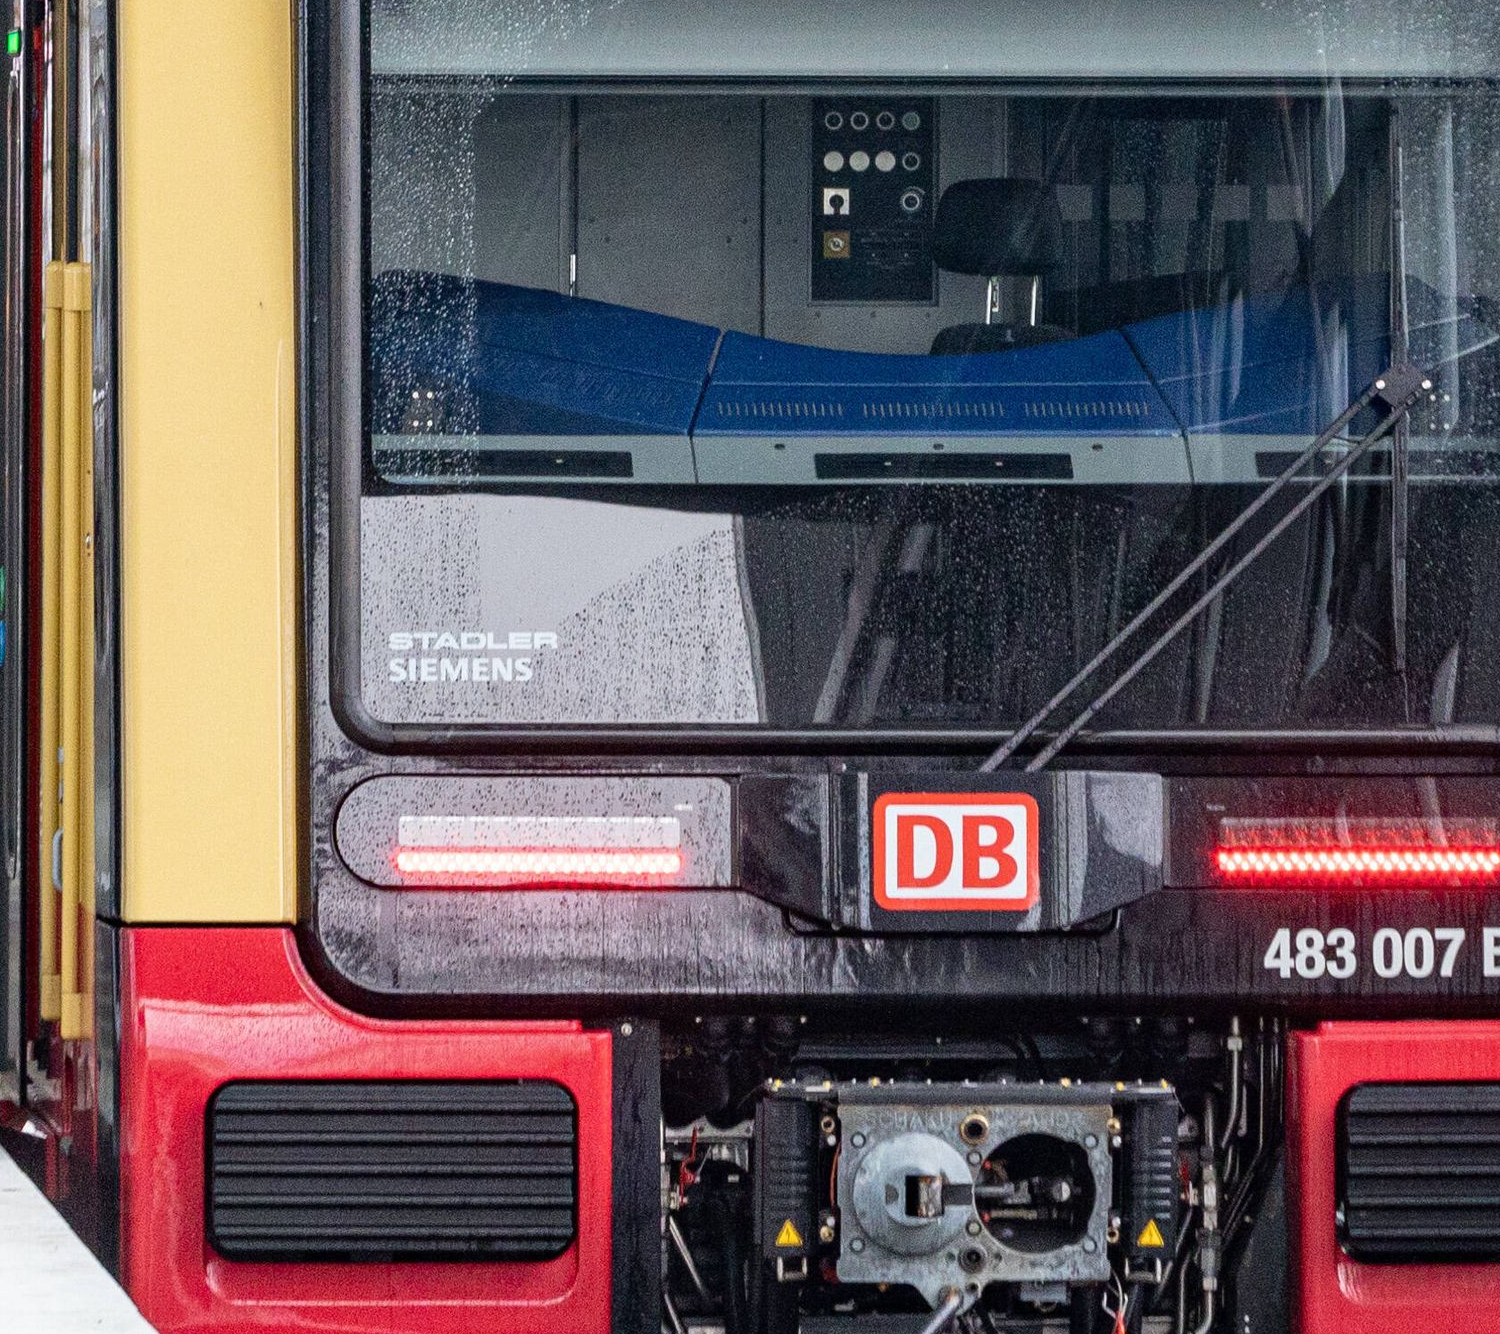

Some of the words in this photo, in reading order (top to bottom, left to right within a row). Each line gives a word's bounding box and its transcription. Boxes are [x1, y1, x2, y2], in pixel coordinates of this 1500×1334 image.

[388, 631, 559, 651] STADLER
[388, 657, 534, 683] SIEMENS
[897, 814, 1020, 890] DB
[1263, 927, 1356, 979] 483
[1371, 927, 1465, 980] 007
